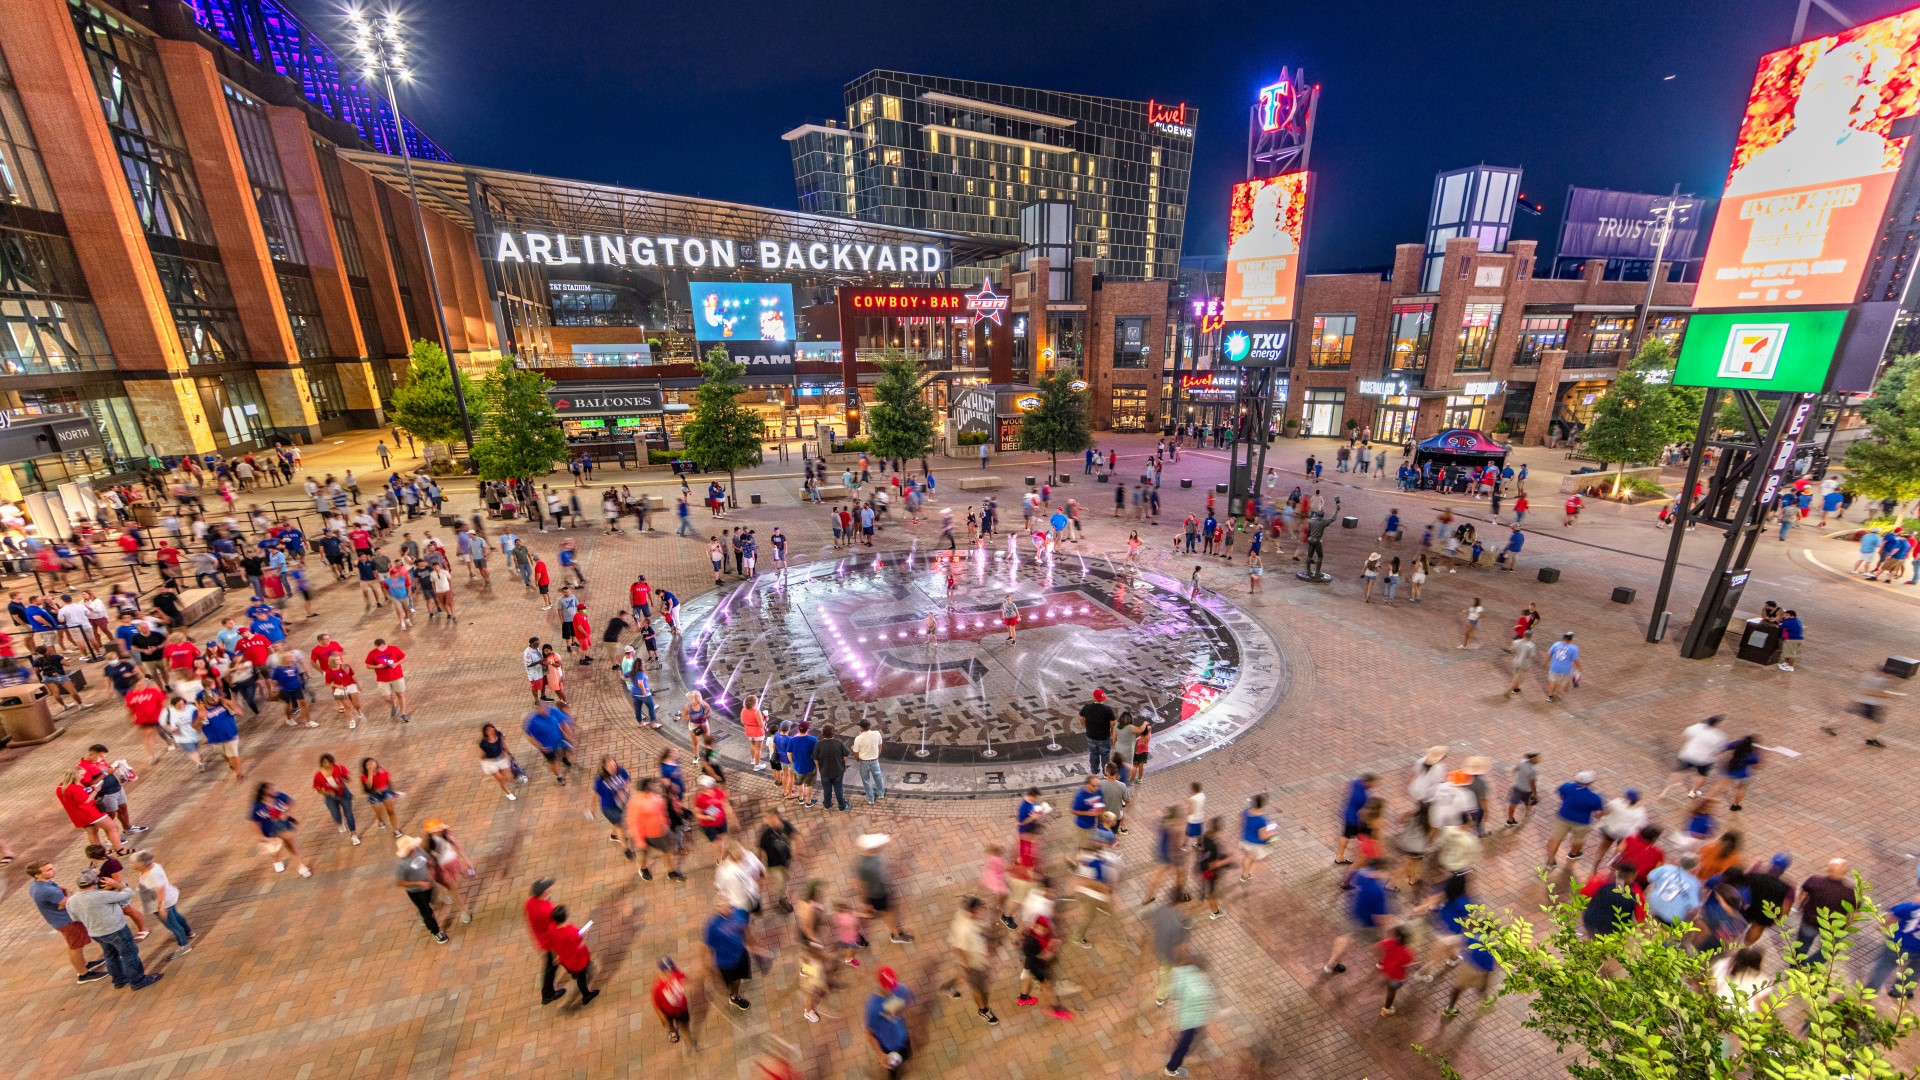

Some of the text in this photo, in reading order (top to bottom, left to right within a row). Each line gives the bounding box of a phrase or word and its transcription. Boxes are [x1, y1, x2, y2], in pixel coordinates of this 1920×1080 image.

[1148, 99, 1185, 125] Live!
[1162, 124, 1192, 137] LOEWS
[1597, 217, 1651, 239] TRUIST
[498, 232, 941, 272] ARLINGTON BACKYARD
[854, 295, 959, 308] COWBOY BAR
[1252, 333, 1286, 349] TXU
[734, 354, 791, 365] RAM
[1250, 350, 1281, 360] energy
[1182, 373, 1213, 388] Live!
[1212, 377, 1237, 386] AREN
[574, 396, 652, 409] BALCONES
[58, 428, 90, 442] NORTH
[242, 640, 265, 649] TEXAS
